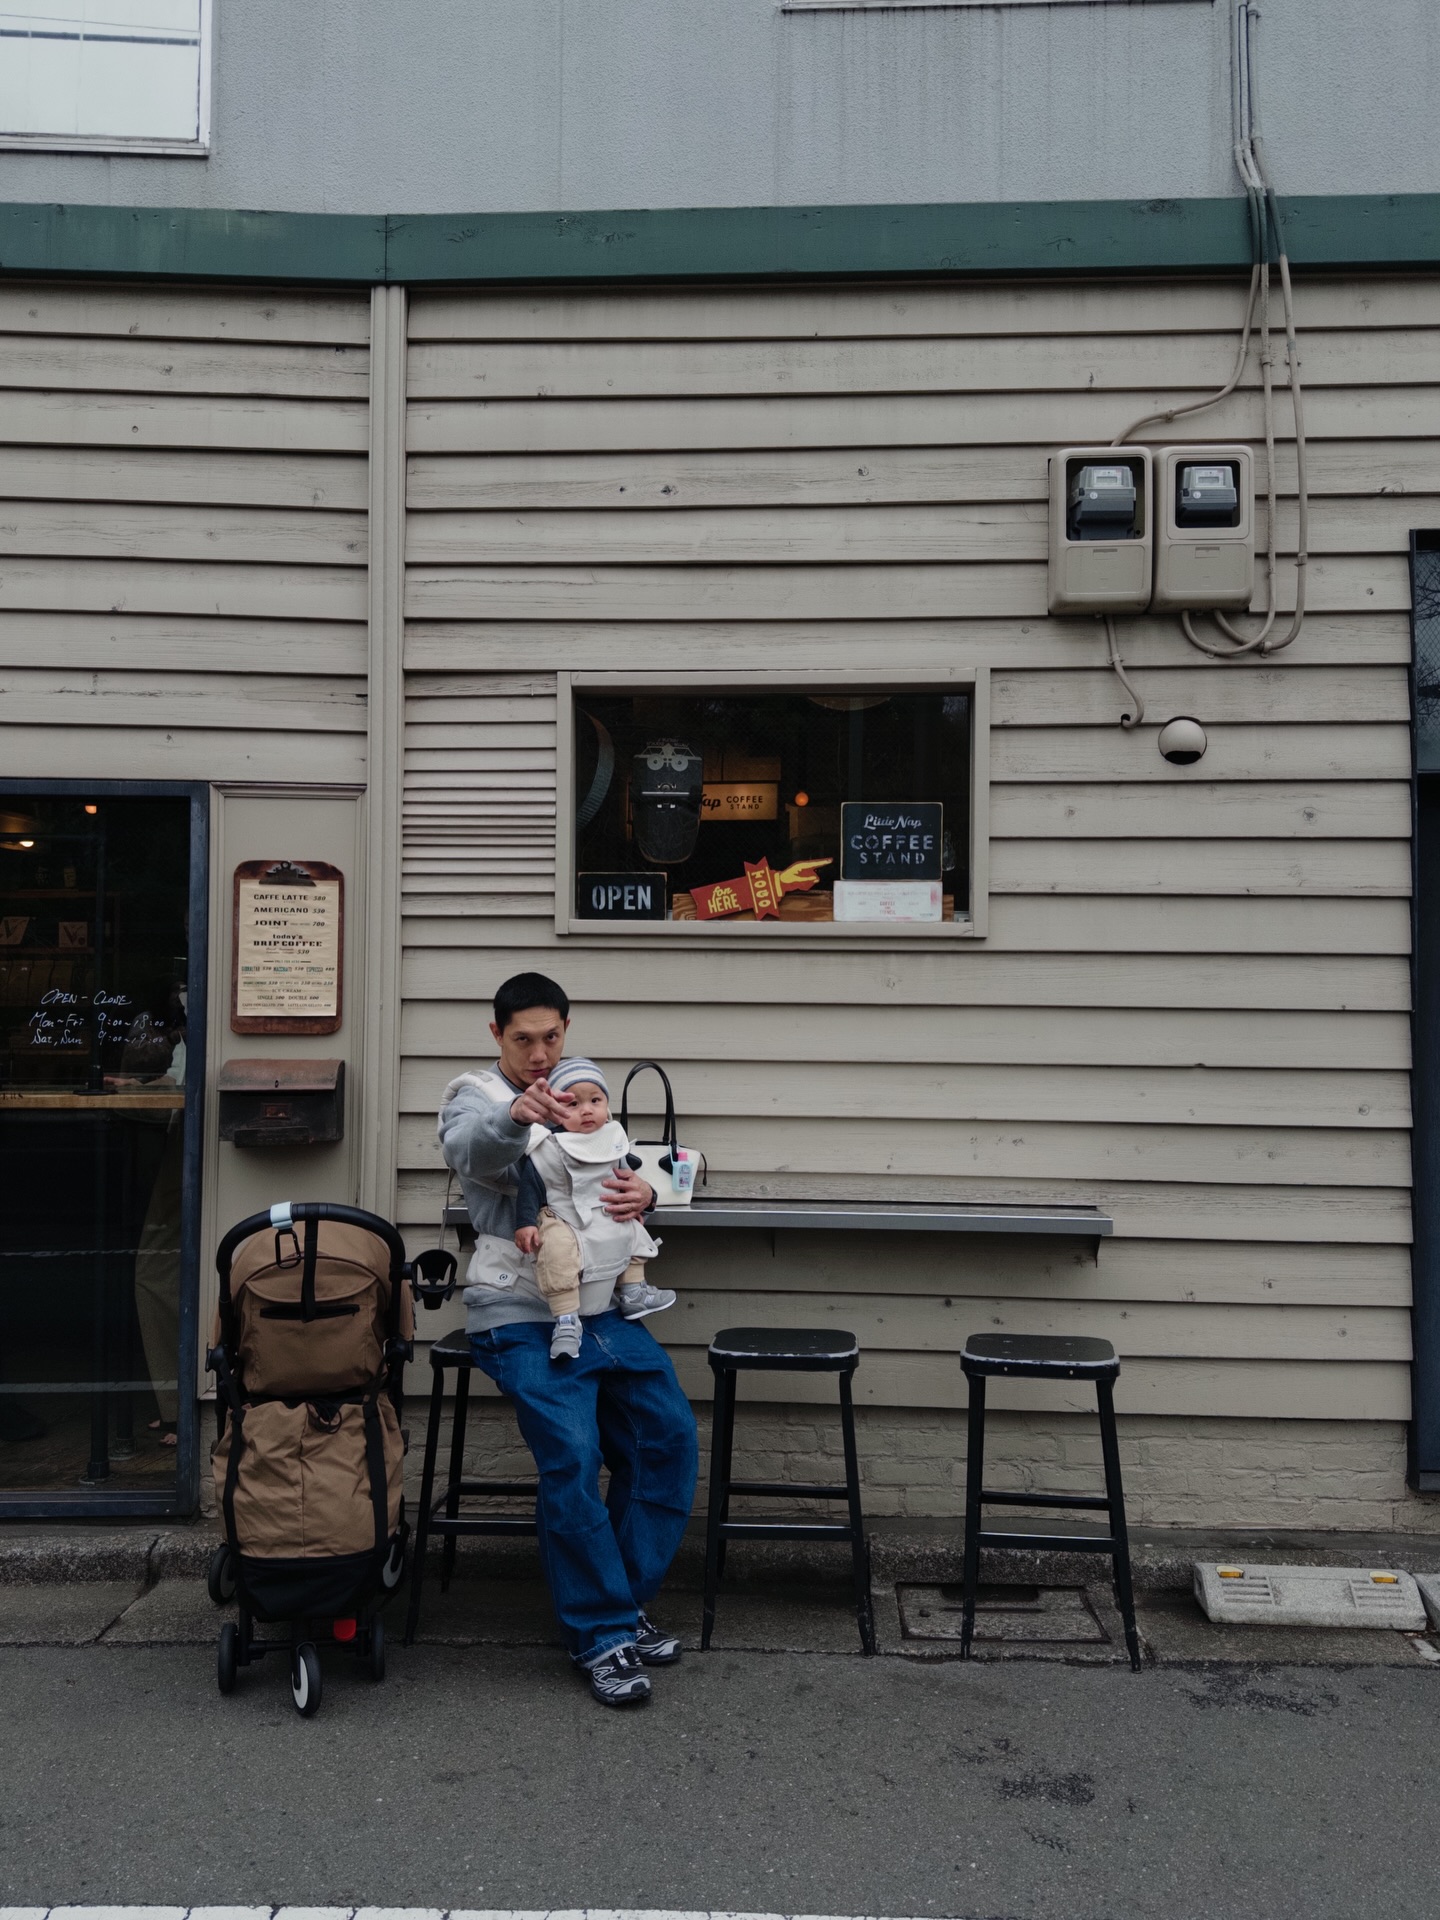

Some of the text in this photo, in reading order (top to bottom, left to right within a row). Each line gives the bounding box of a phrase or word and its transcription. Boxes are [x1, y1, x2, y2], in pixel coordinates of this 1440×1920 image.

[726, 795, 764, 804] COFFEE
[891, 815, 922, 830] Nap
[850, 834, 934, 850] COFFEE
[860, 851, 926, 865] STAND
[592, 885, 652, 910] OPEN
[41, 988, 78, 1005] OPEN
[93, 990, 132, 1005] CLOSE
